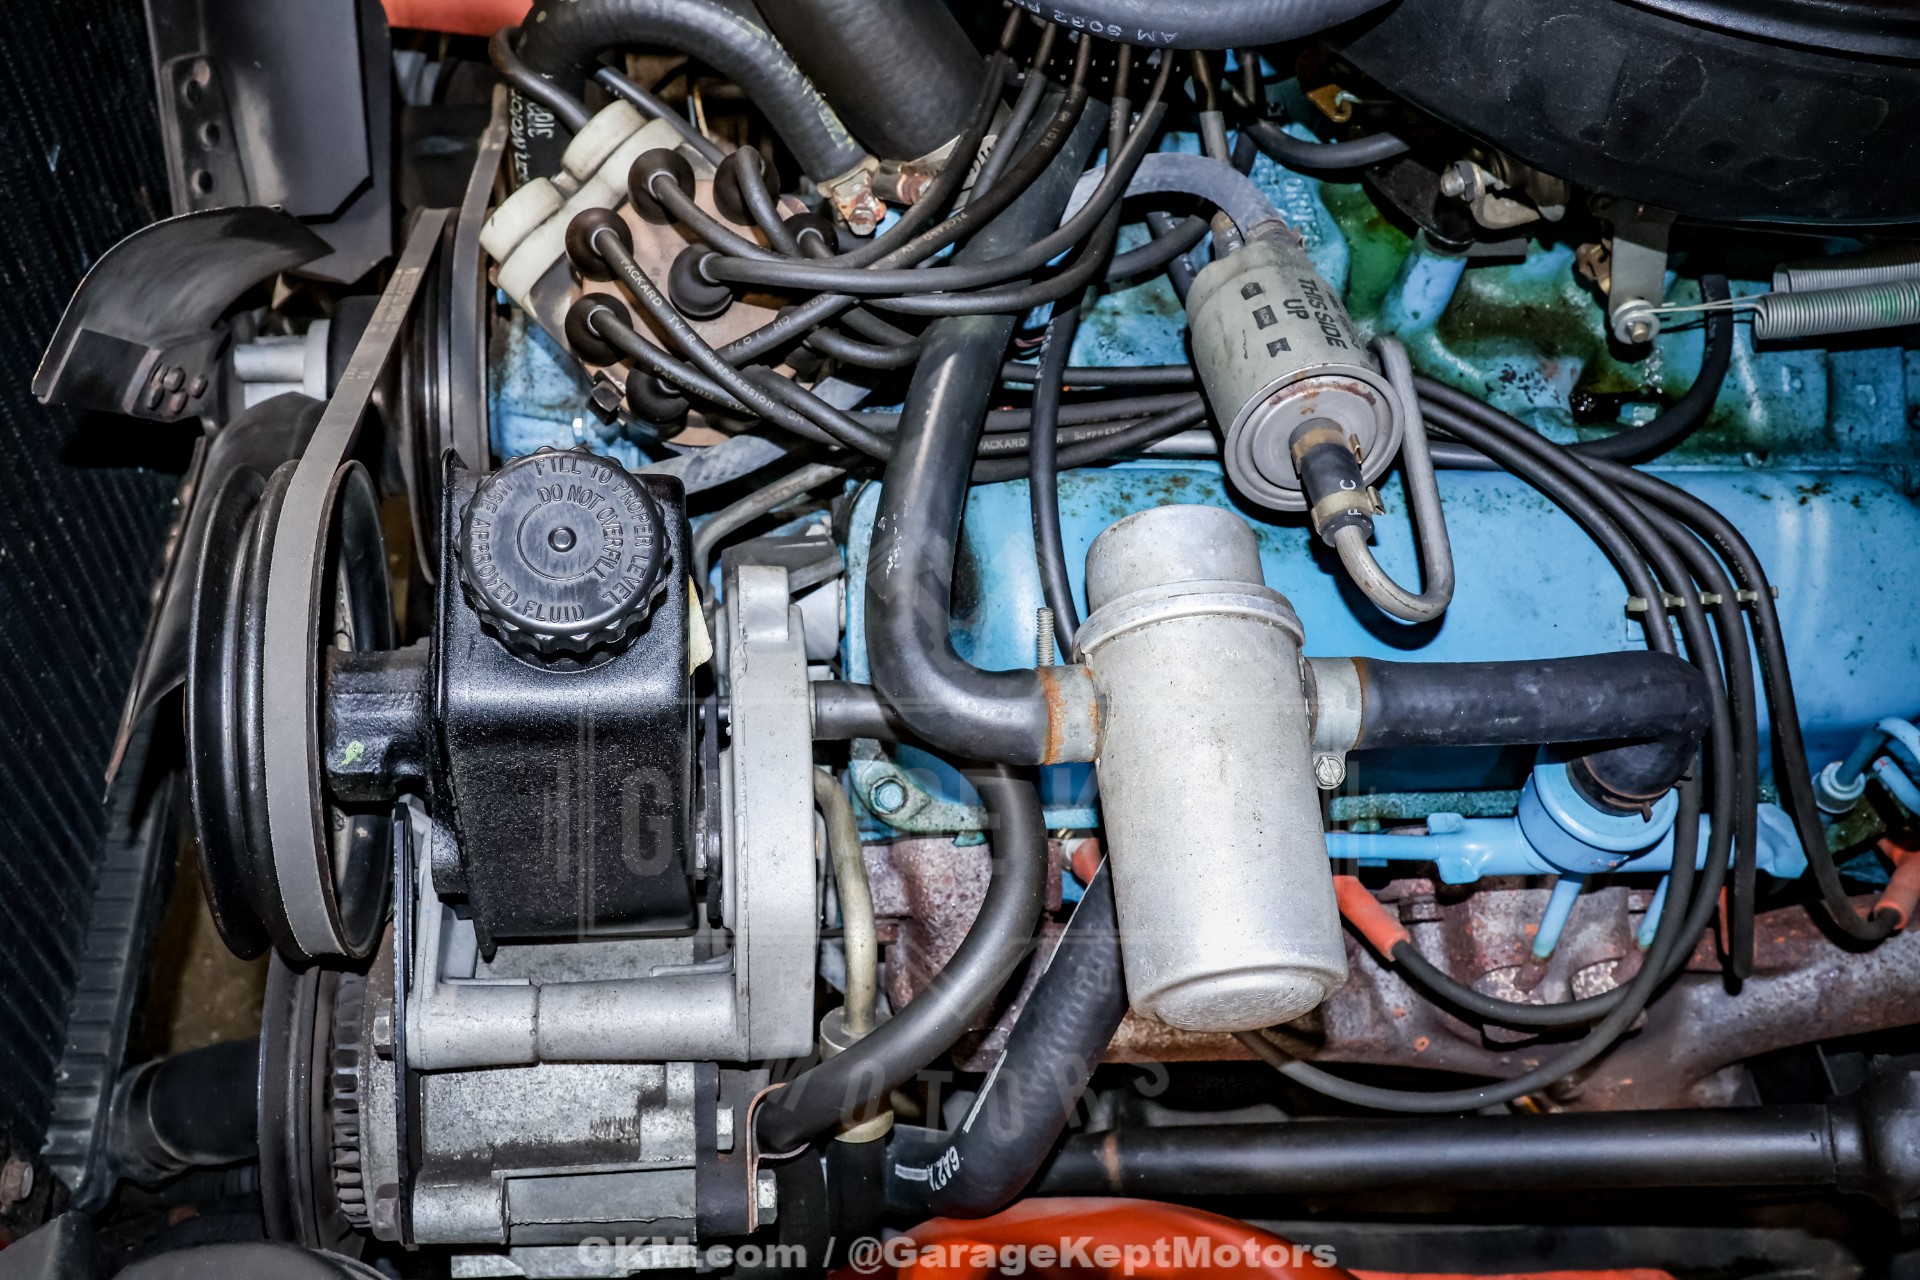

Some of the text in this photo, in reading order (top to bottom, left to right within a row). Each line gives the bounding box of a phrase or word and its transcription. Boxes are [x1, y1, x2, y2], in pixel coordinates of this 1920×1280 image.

[620, 258, 663, 307] PACKARD
[701, 350, 776, 410] SUPPRESSION
[1283, 298, 1310, 320] UP
[1298, 278, 1329, 317] THIS
[1314, 311, 1348, 350] SIDE
[980, 438, 1027, 451] ACKARD
[470, 480, 584, 623] USE APPROVED FLUID
[534, 457, 653, 605] FILL TO PROPER LEVEL
[537, 484, 624, 579] DO NOT OVERFILL
